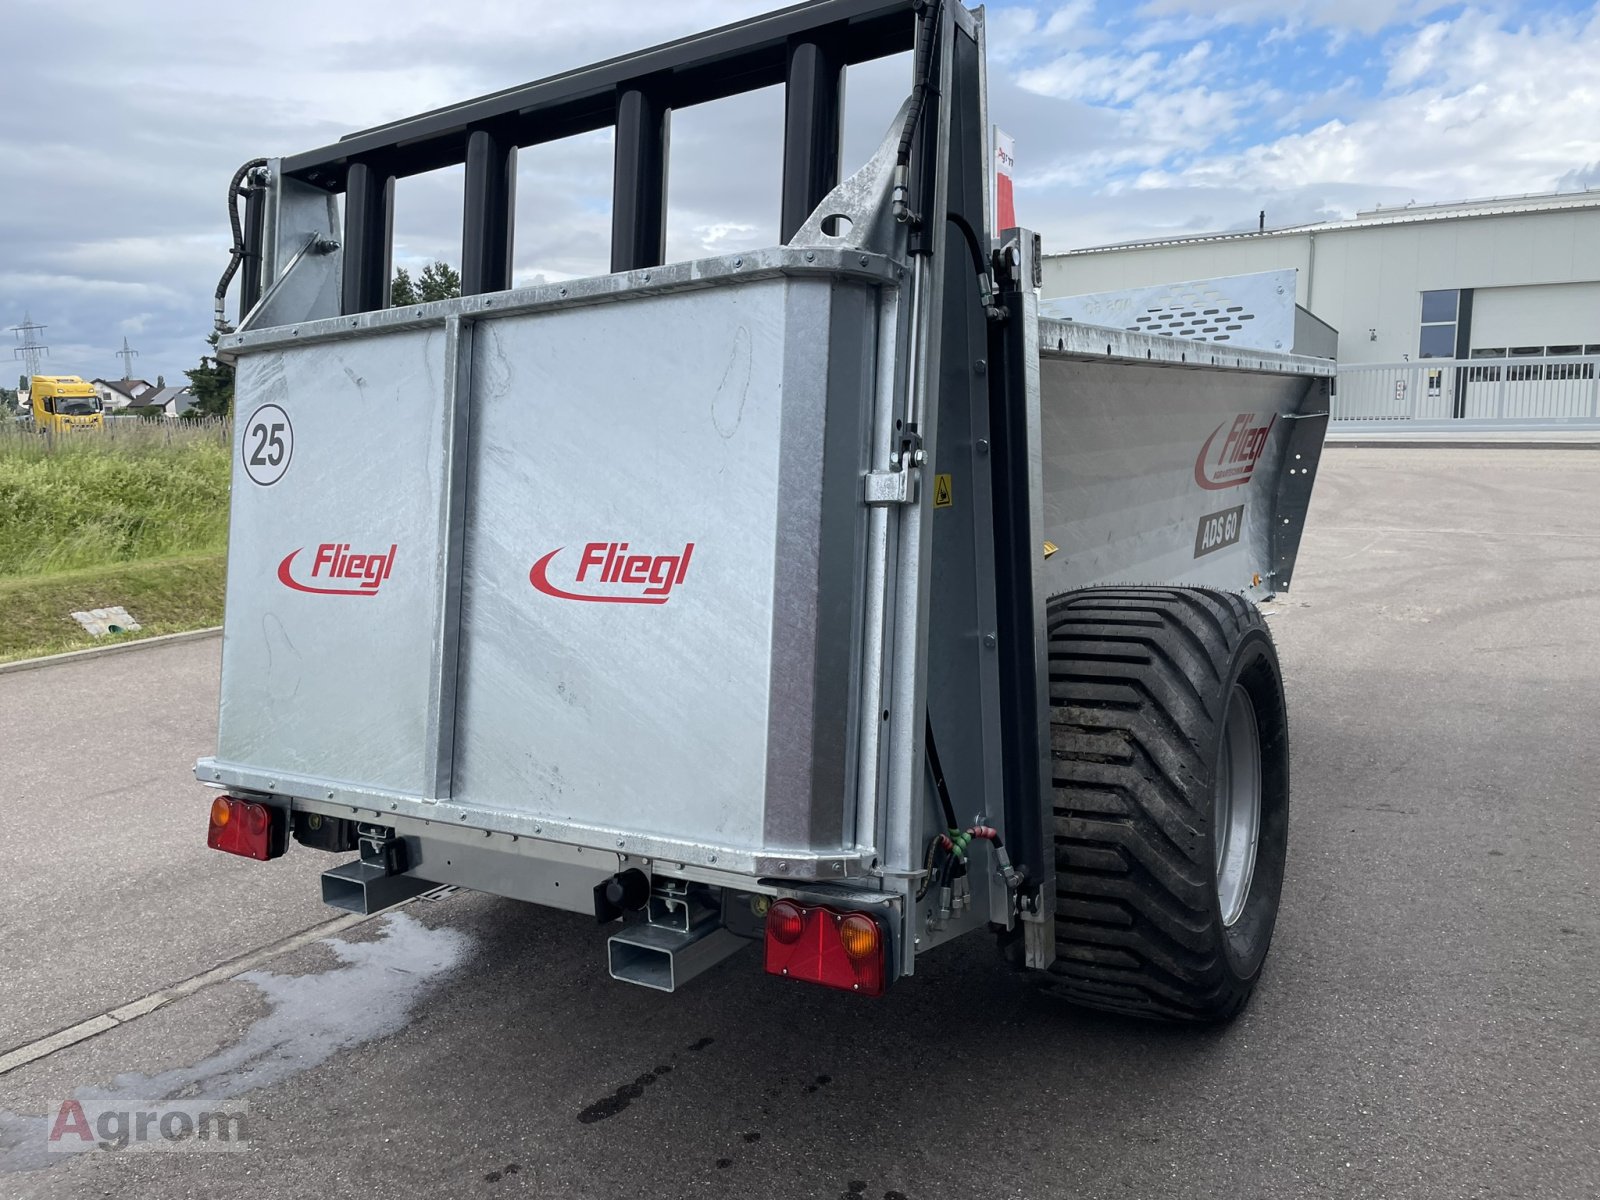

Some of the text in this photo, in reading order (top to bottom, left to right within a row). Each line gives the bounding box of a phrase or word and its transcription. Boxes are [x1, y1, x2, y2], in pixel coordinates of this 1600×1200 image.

[250, 423, 285, 466] 25
[1218, 412, 1278, 474] Fliegl
[1202, 512, 1238, 550] ADS 60
[311, 543, 398, 588] Fliegl
[575, 542, 695, 595] Fliegl
